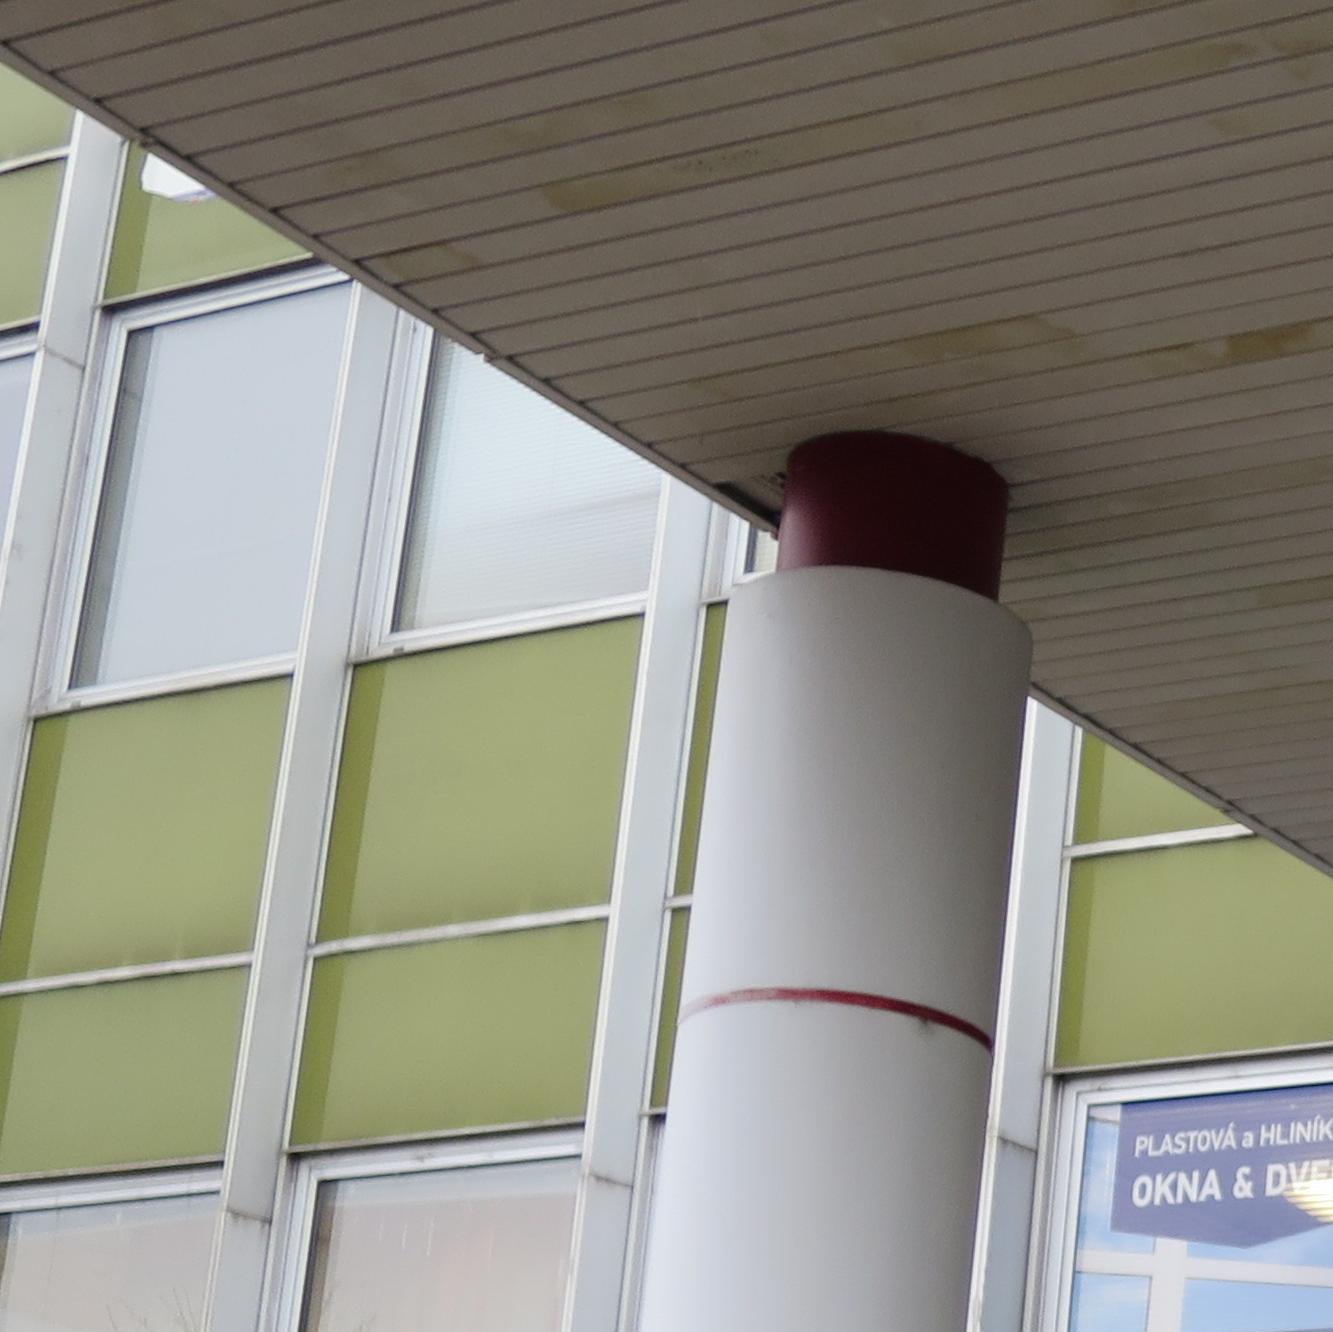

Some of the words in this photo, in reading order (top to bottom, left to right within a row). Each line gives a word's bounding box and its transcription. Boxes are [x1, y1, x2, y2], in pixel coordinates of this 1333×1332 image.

[1133, 1121, 1237, 1158] PLASTOVÁ
[1241, 1130, 1254, 1149] a
[1131, 1168, 1222, 1207] OKNA
[1232, 1165, 1255, 1200] &
